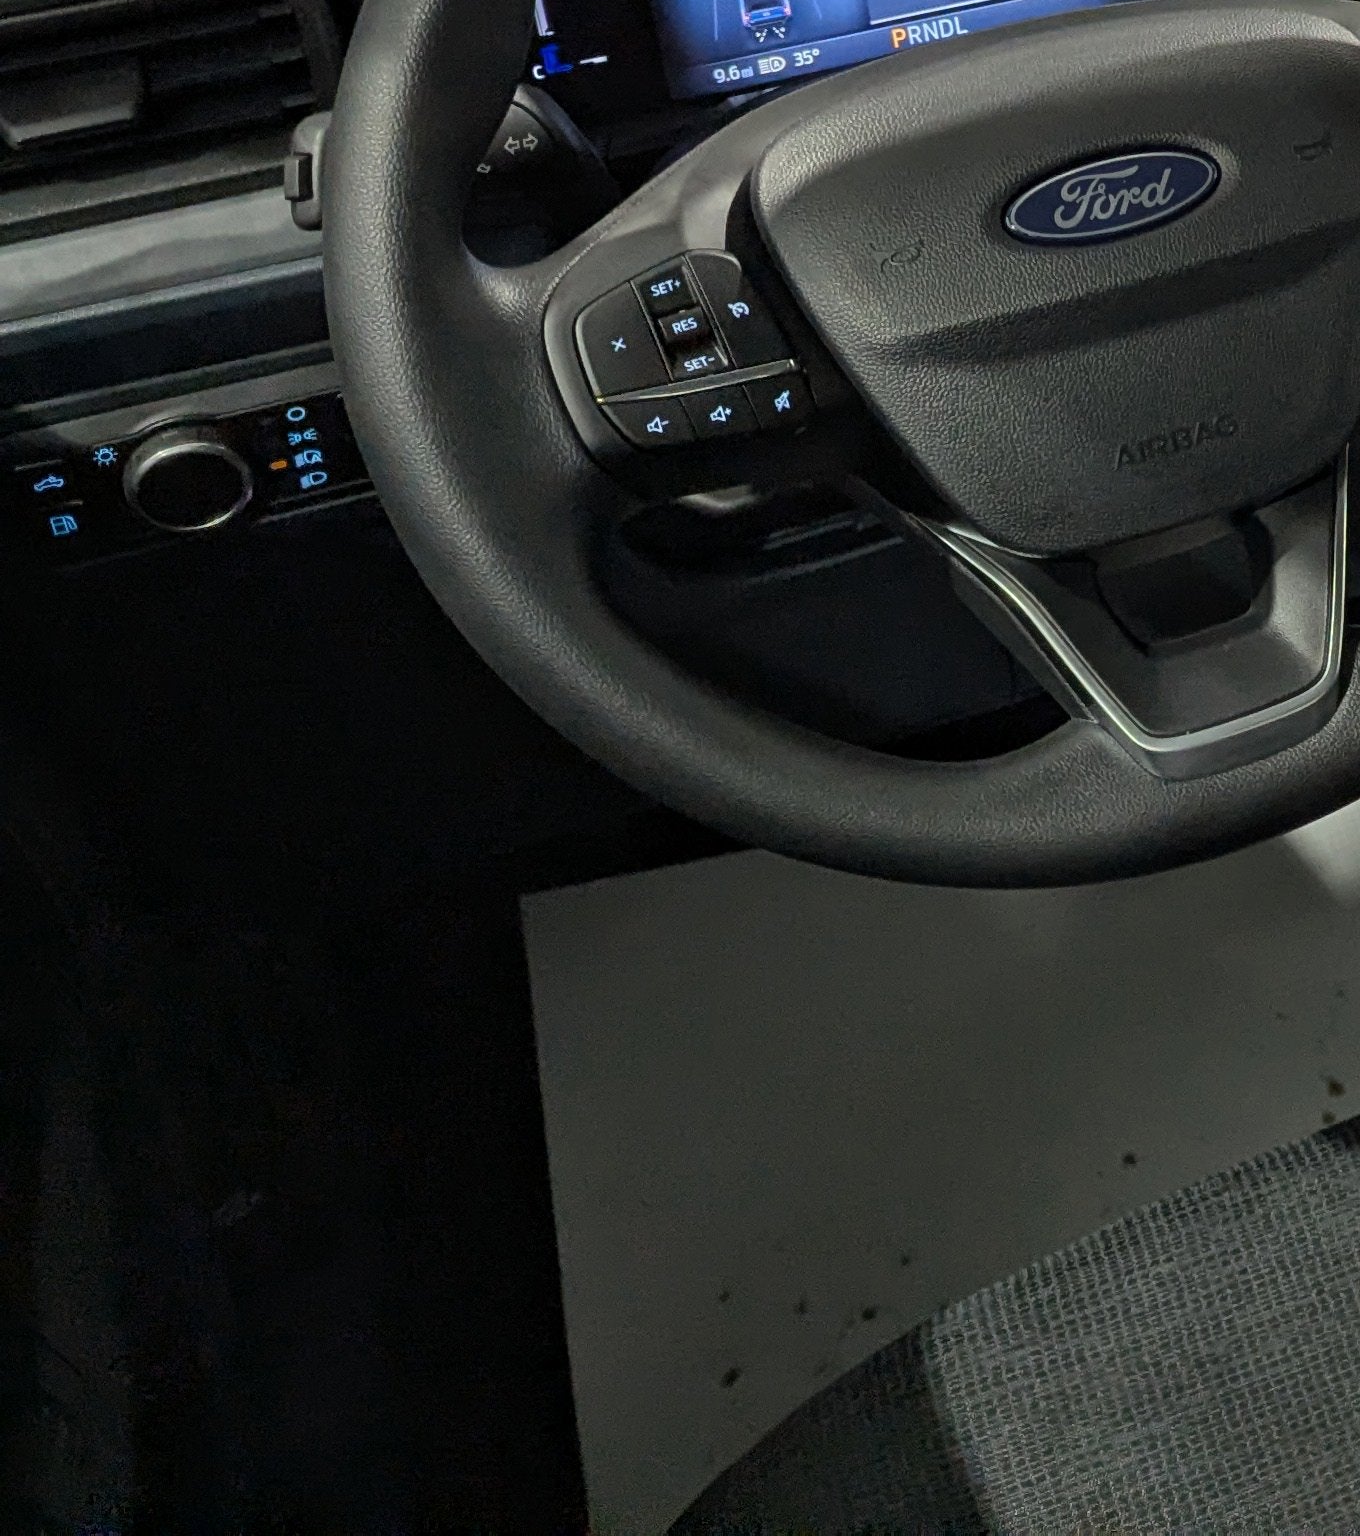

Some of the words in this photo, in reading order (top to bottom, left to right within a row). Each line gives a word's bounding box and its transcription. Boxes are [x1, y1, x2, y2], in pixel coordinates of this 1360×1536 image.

[713, 62, 741, 84] 9.6
[1053, 165, 1175, 230] Ford
[671, 317, 698, 335] RES
[1113, 414, 1238, 470] AIRBAG
